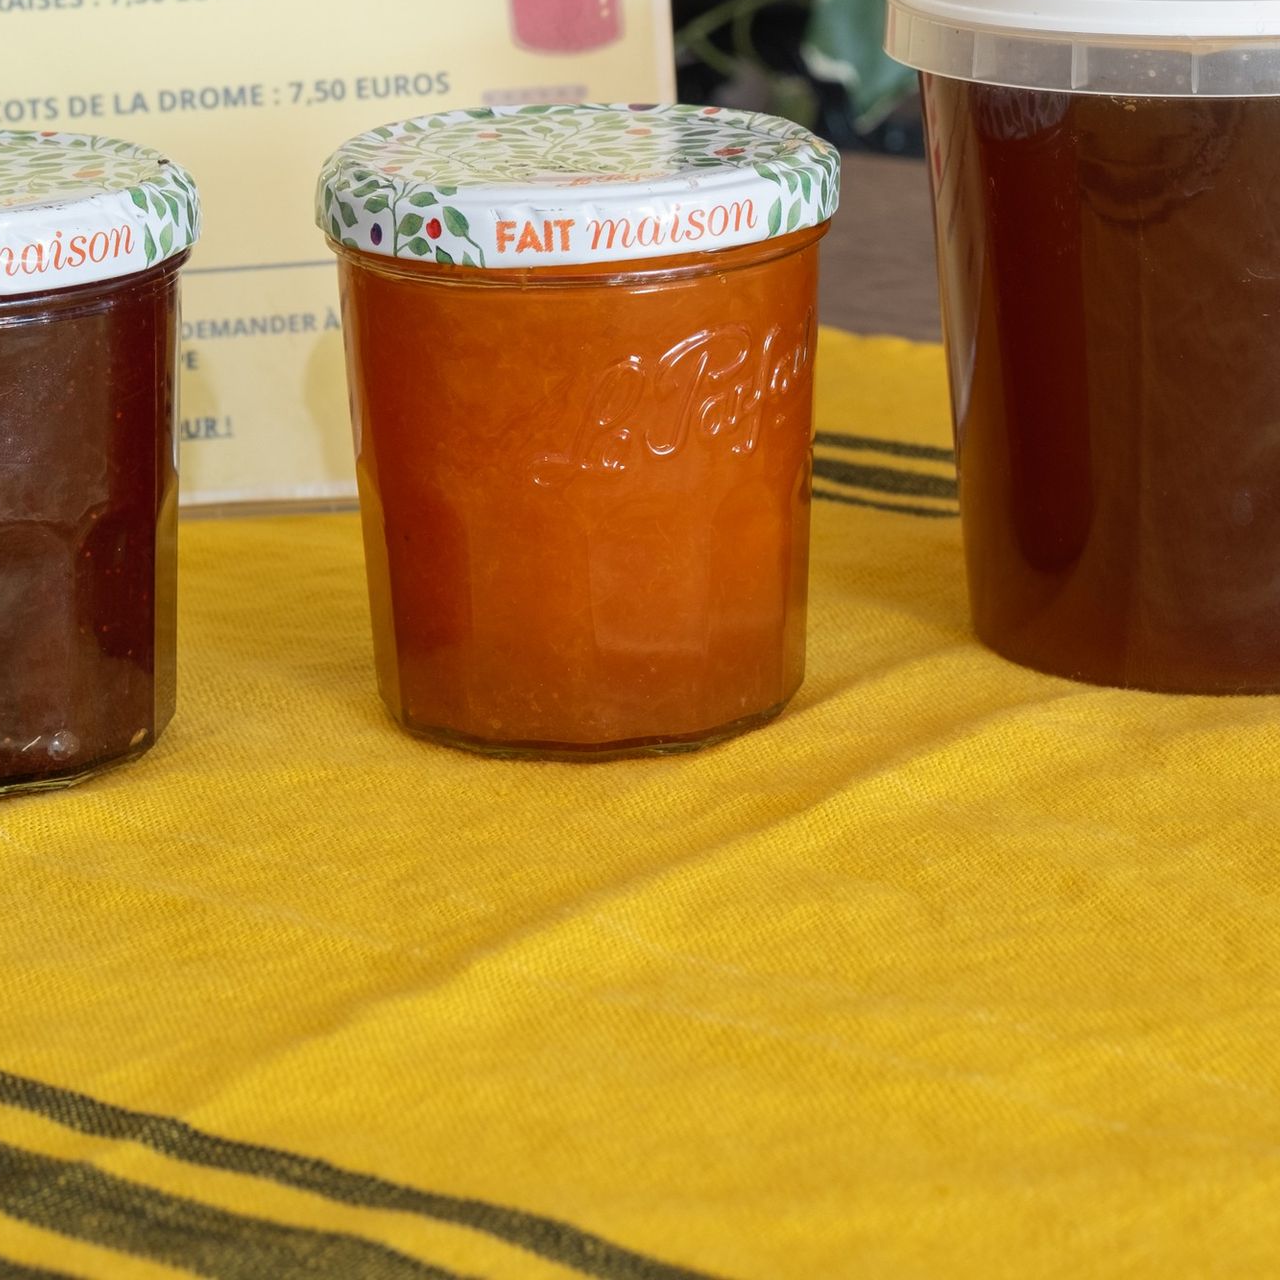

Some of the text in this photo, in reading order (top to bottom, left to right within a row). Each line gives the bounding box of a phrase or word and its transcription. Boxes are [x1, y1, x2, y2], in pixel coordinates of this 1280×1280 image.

[69, 93, 105, 117] DE
[113, 90, 149, 115] LA
[158, 83, 264, 113] DROME
[288, 79, 346, 107] 7,50
[356, 72, 451, 100] EUROS
[496, 197, 758, 254] FAIT maison
